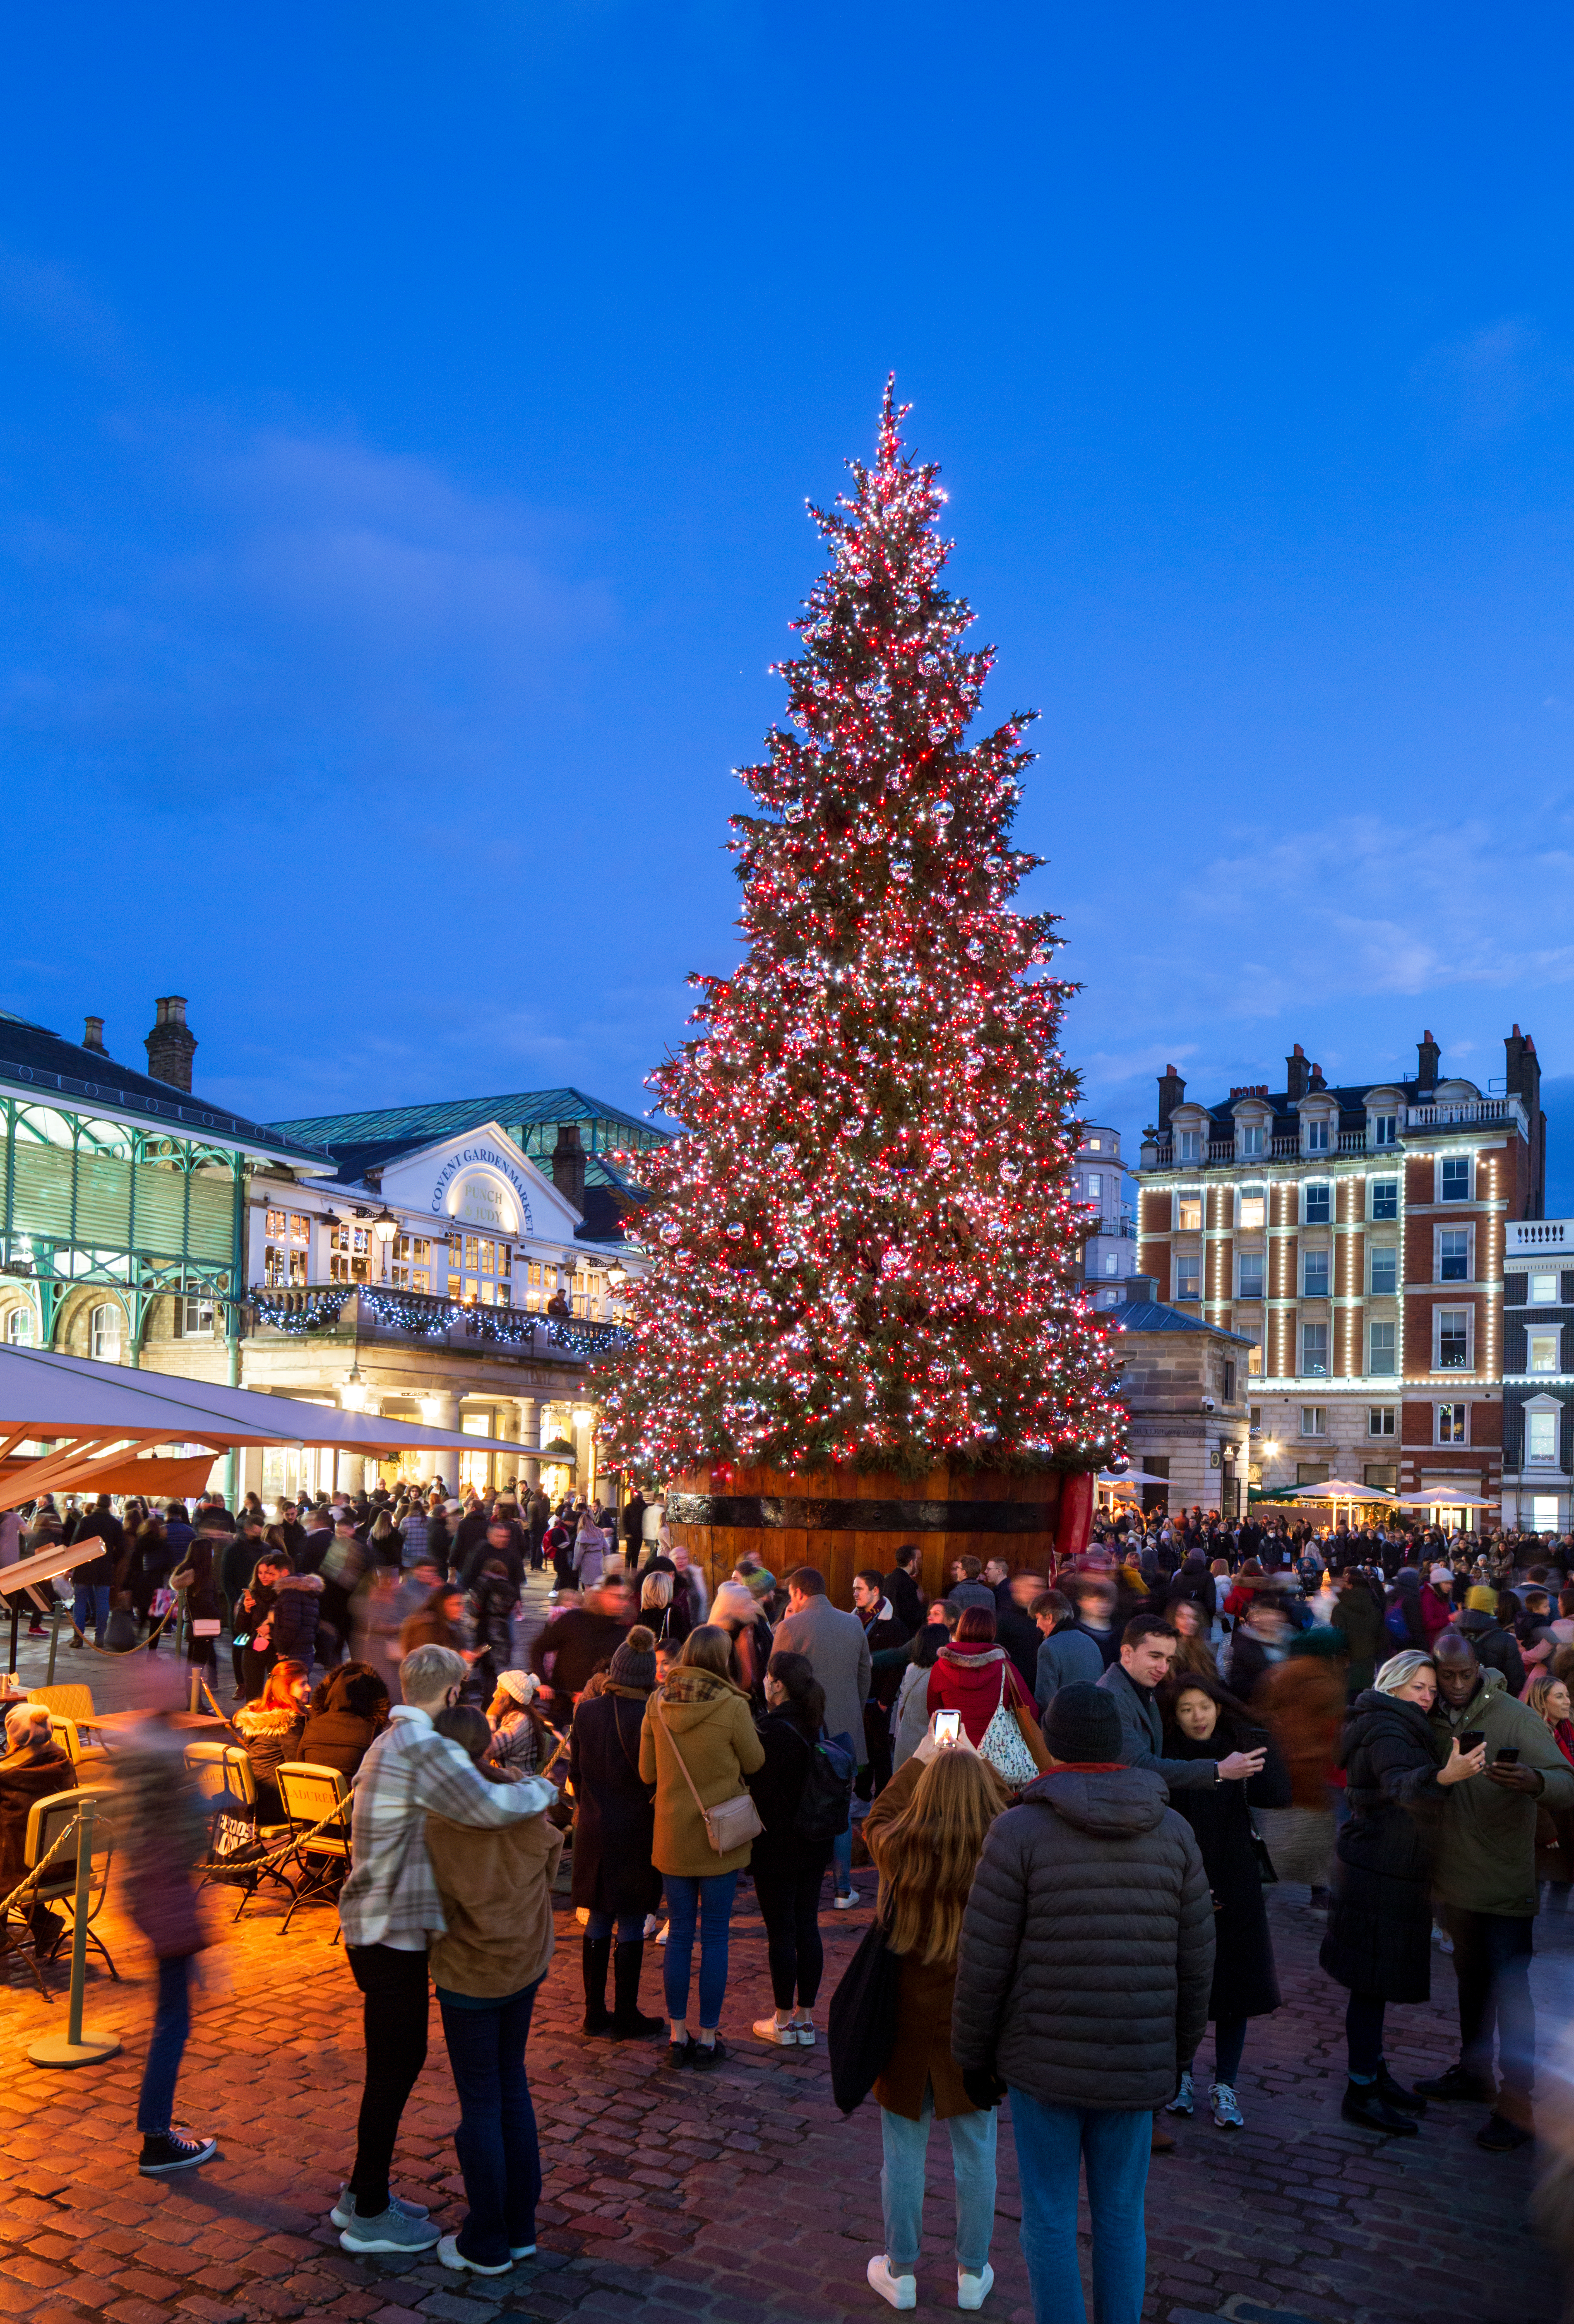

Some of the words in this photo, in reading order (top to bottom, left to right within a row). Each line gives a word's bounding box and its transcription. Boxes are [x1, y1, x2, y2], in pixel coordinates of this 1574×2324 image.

[432, 1154, 461, 1212] COVENT
[464, 1149, 510, 1174] GARDEN
[508, 1168, 533, 1235] MARKET
[465, 1185, 502, 1204] PUNCH
[465, 1205, 472, 1216] &
[474, 1206, 502, 1223] JUDY
[285, 1787, 336, 1804] LADURÉE
